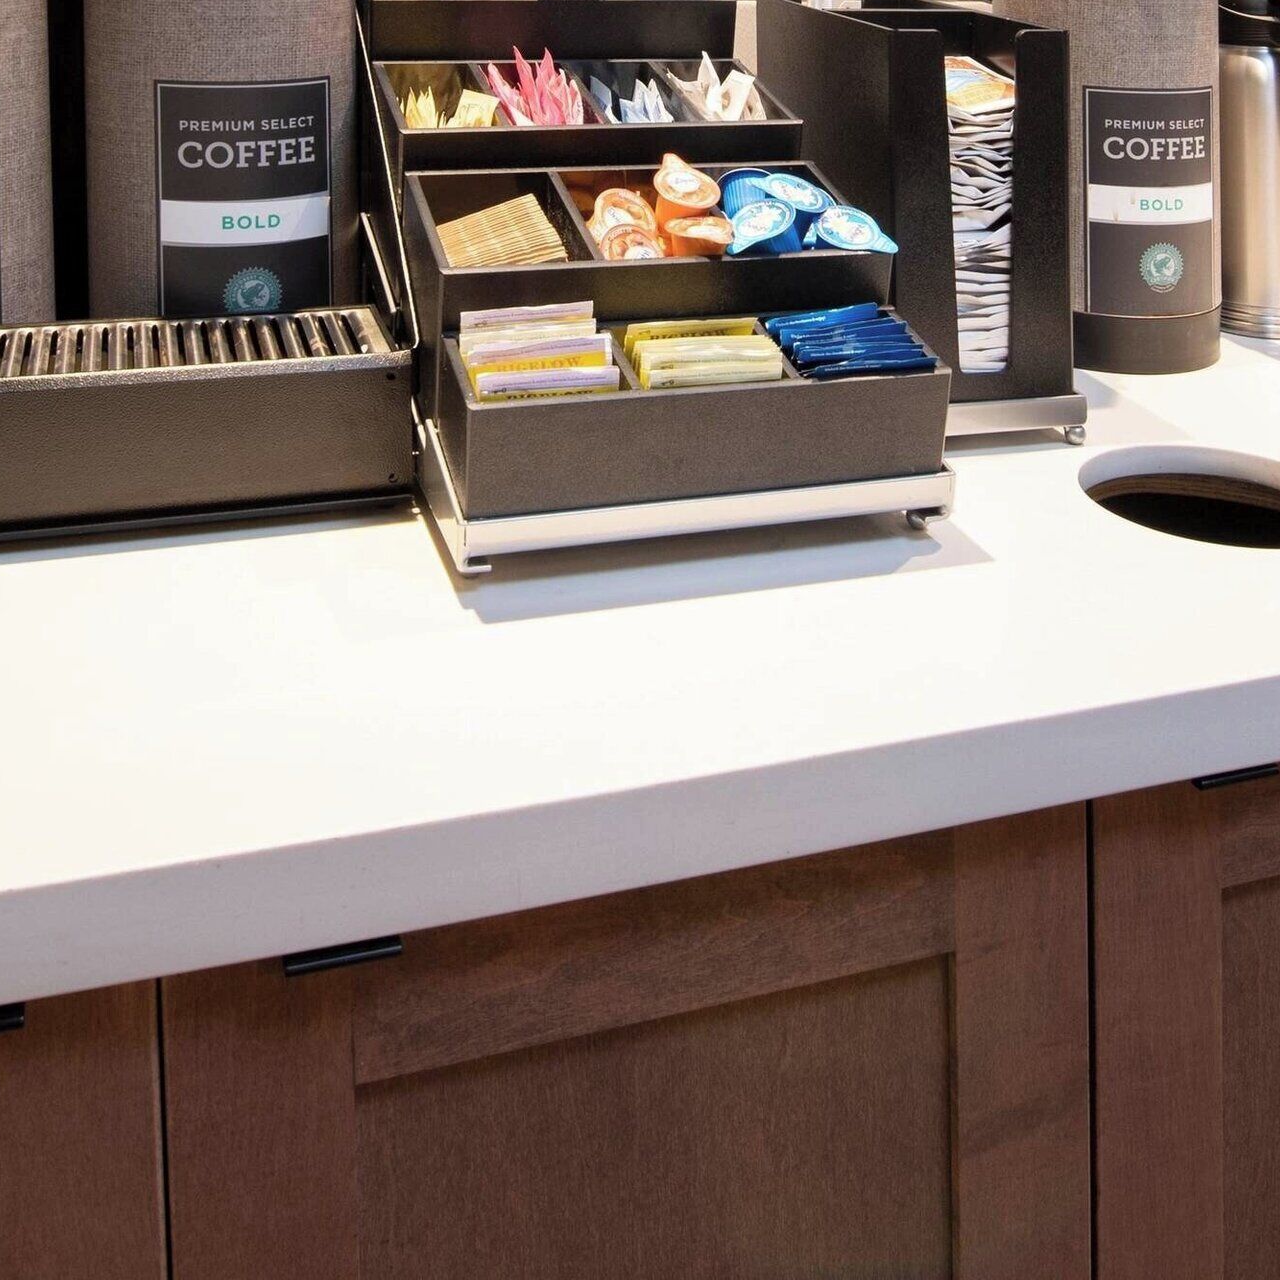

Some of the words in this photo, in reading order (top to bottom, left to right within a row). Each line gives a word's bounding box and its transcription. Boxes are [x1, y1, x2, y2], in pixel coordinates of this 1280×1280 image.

[179, 119, 255, 132] PREMIUM
[261, 115, 315, 131] SELECT
[1104, 118, 1165, 130] PREMIUM
[1169, 118, 1205, 130] SELECT
[177, 135, 316, 169] COFFEE
[1103, 135, 1206, 160] COFFEE
[1139, 199, 1184, 211] BOLD
[221, 214, 281, 230] BOLD
